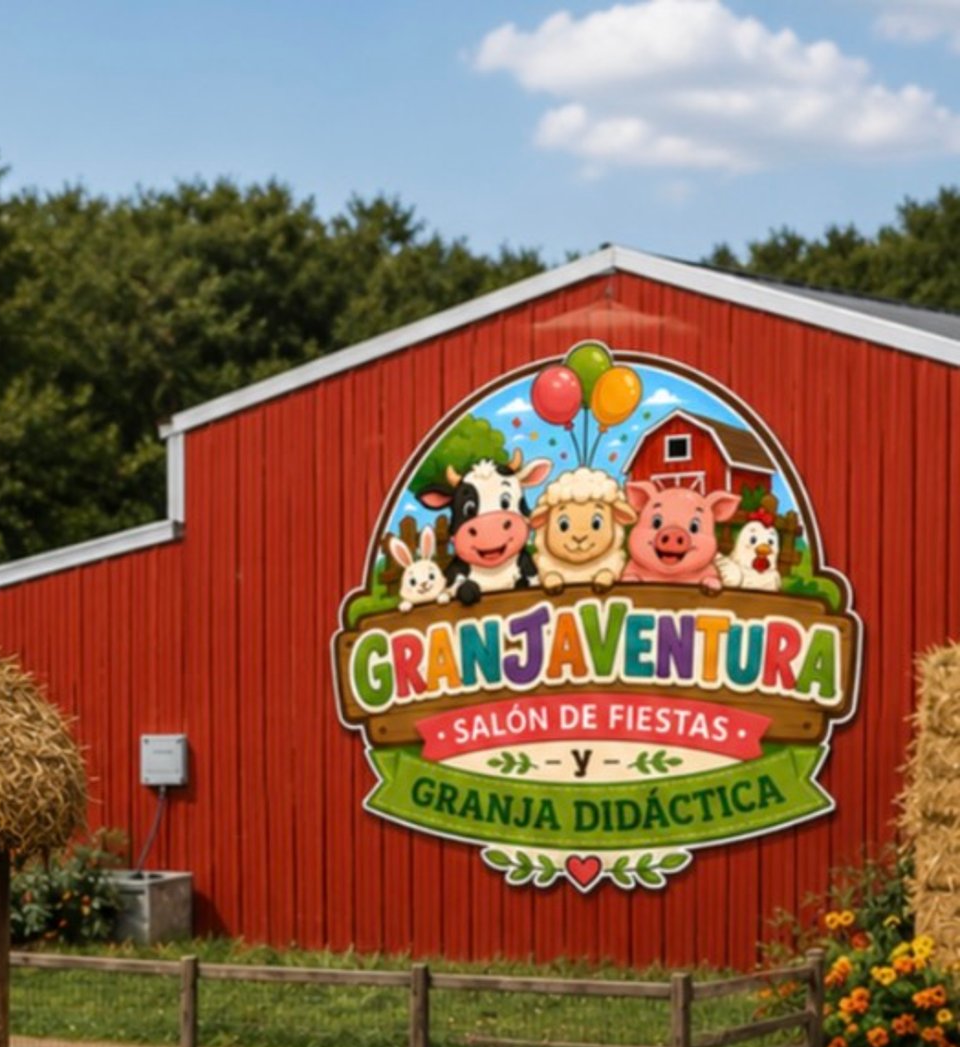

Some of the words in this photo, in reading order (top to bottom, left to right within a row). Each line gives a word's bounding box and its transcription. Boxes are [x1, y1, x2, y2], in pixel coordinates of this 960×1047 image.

[352, 600, 841, 708] GRANJAVENTURA
[452, 703, 549, 744] SALÓN
[559, 705, 598, 730] DE
[609, 704, 730, 743] FIESTAS
[411, 776, 561, 832] GRANJA
[573, 774, 787, 833] DIDÁCTICA
